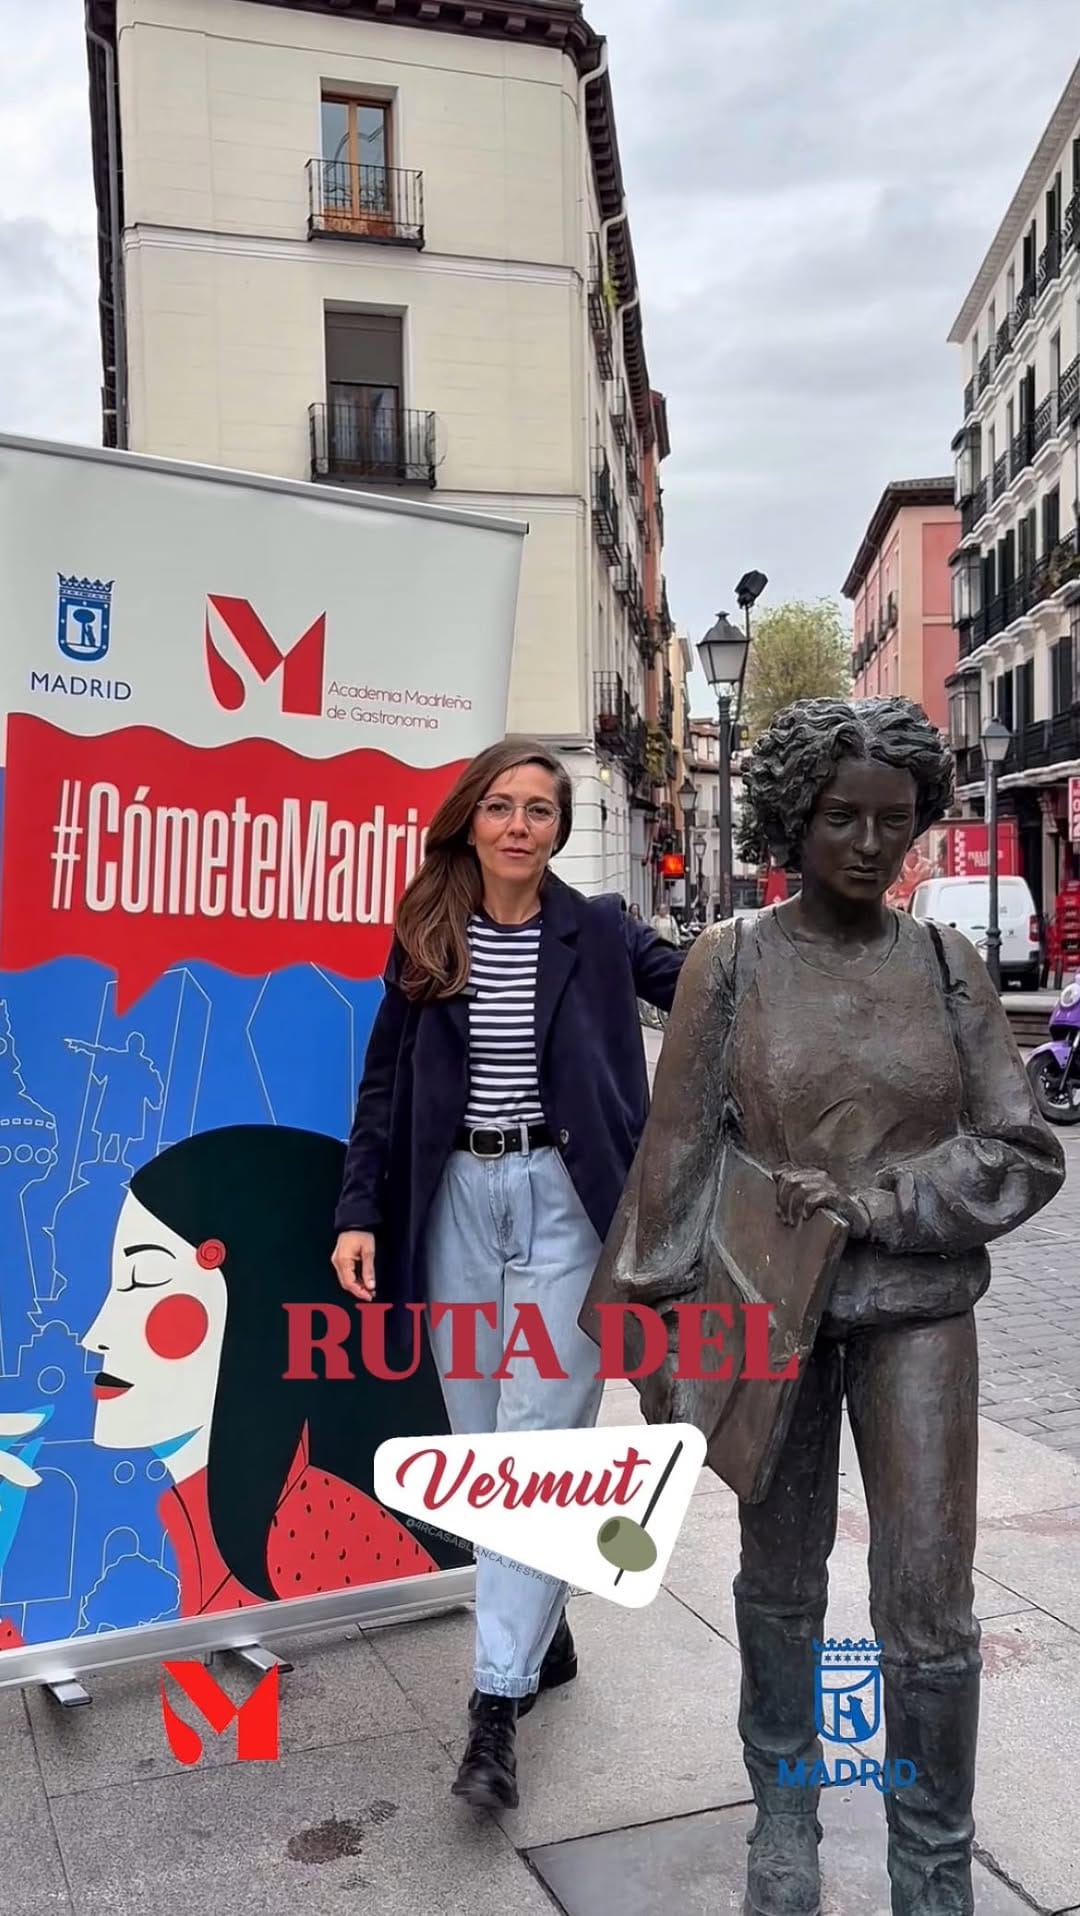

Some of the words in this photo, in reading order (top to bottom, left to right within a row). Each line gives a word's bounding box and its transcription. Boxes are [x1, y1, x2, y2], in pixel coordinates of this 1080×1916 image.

[30, 670, 132, 701] MADRID
[327, 680, 401, 704] Academia
[404, 689, 473, 711] Madrileña
[326, 704, 347, 720] de
